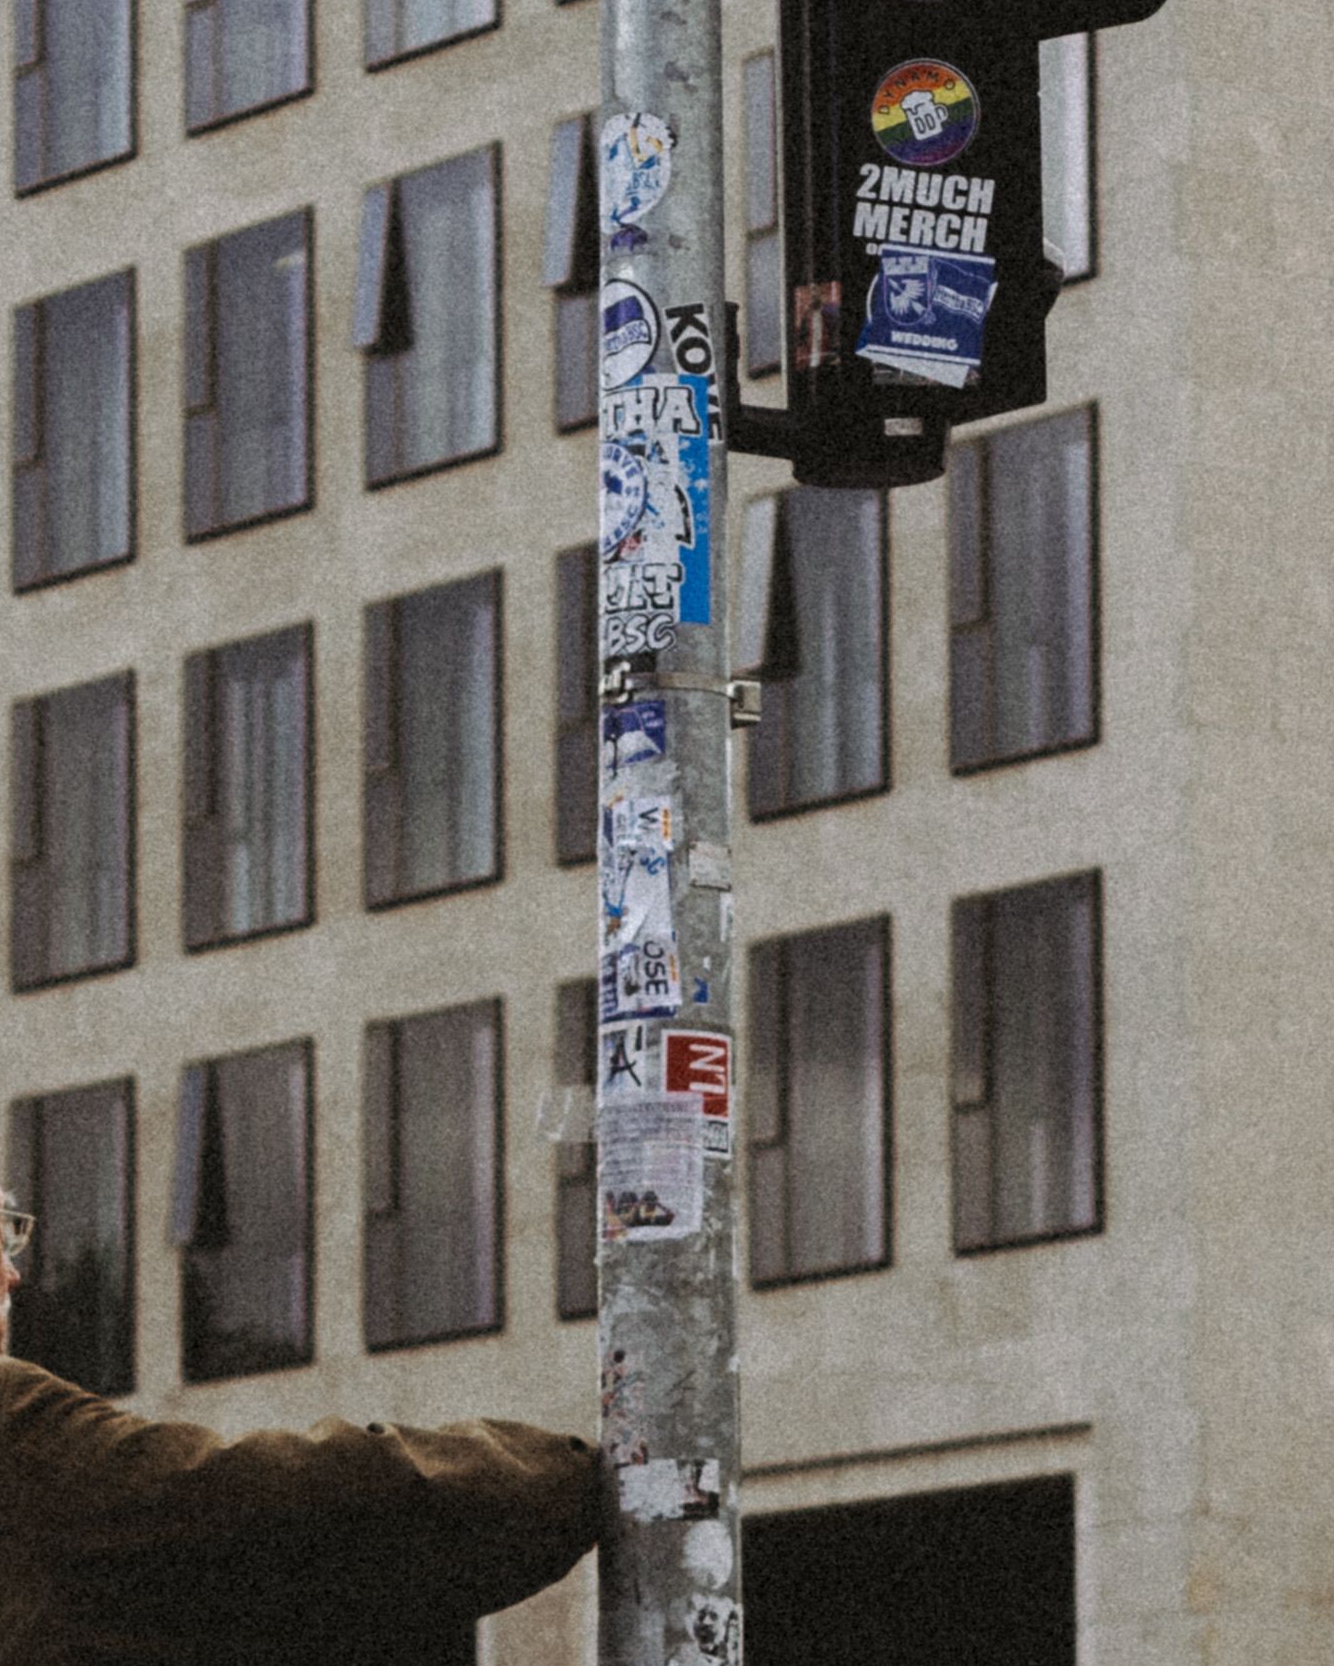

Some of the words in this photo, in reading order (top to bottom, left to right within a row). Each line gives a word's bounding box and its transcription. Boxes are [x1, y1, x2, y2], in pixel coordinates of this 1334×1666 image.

[877, 69, 956, 115] DYNAMO
[914, 113, 938, 135] DD
[856, 163, 995, 214] 2MUCH
[853, 202, 988, 253] MERCH
[891, 330, 959, 352] WEDDING
[605, 612, 677, 654] BSC
